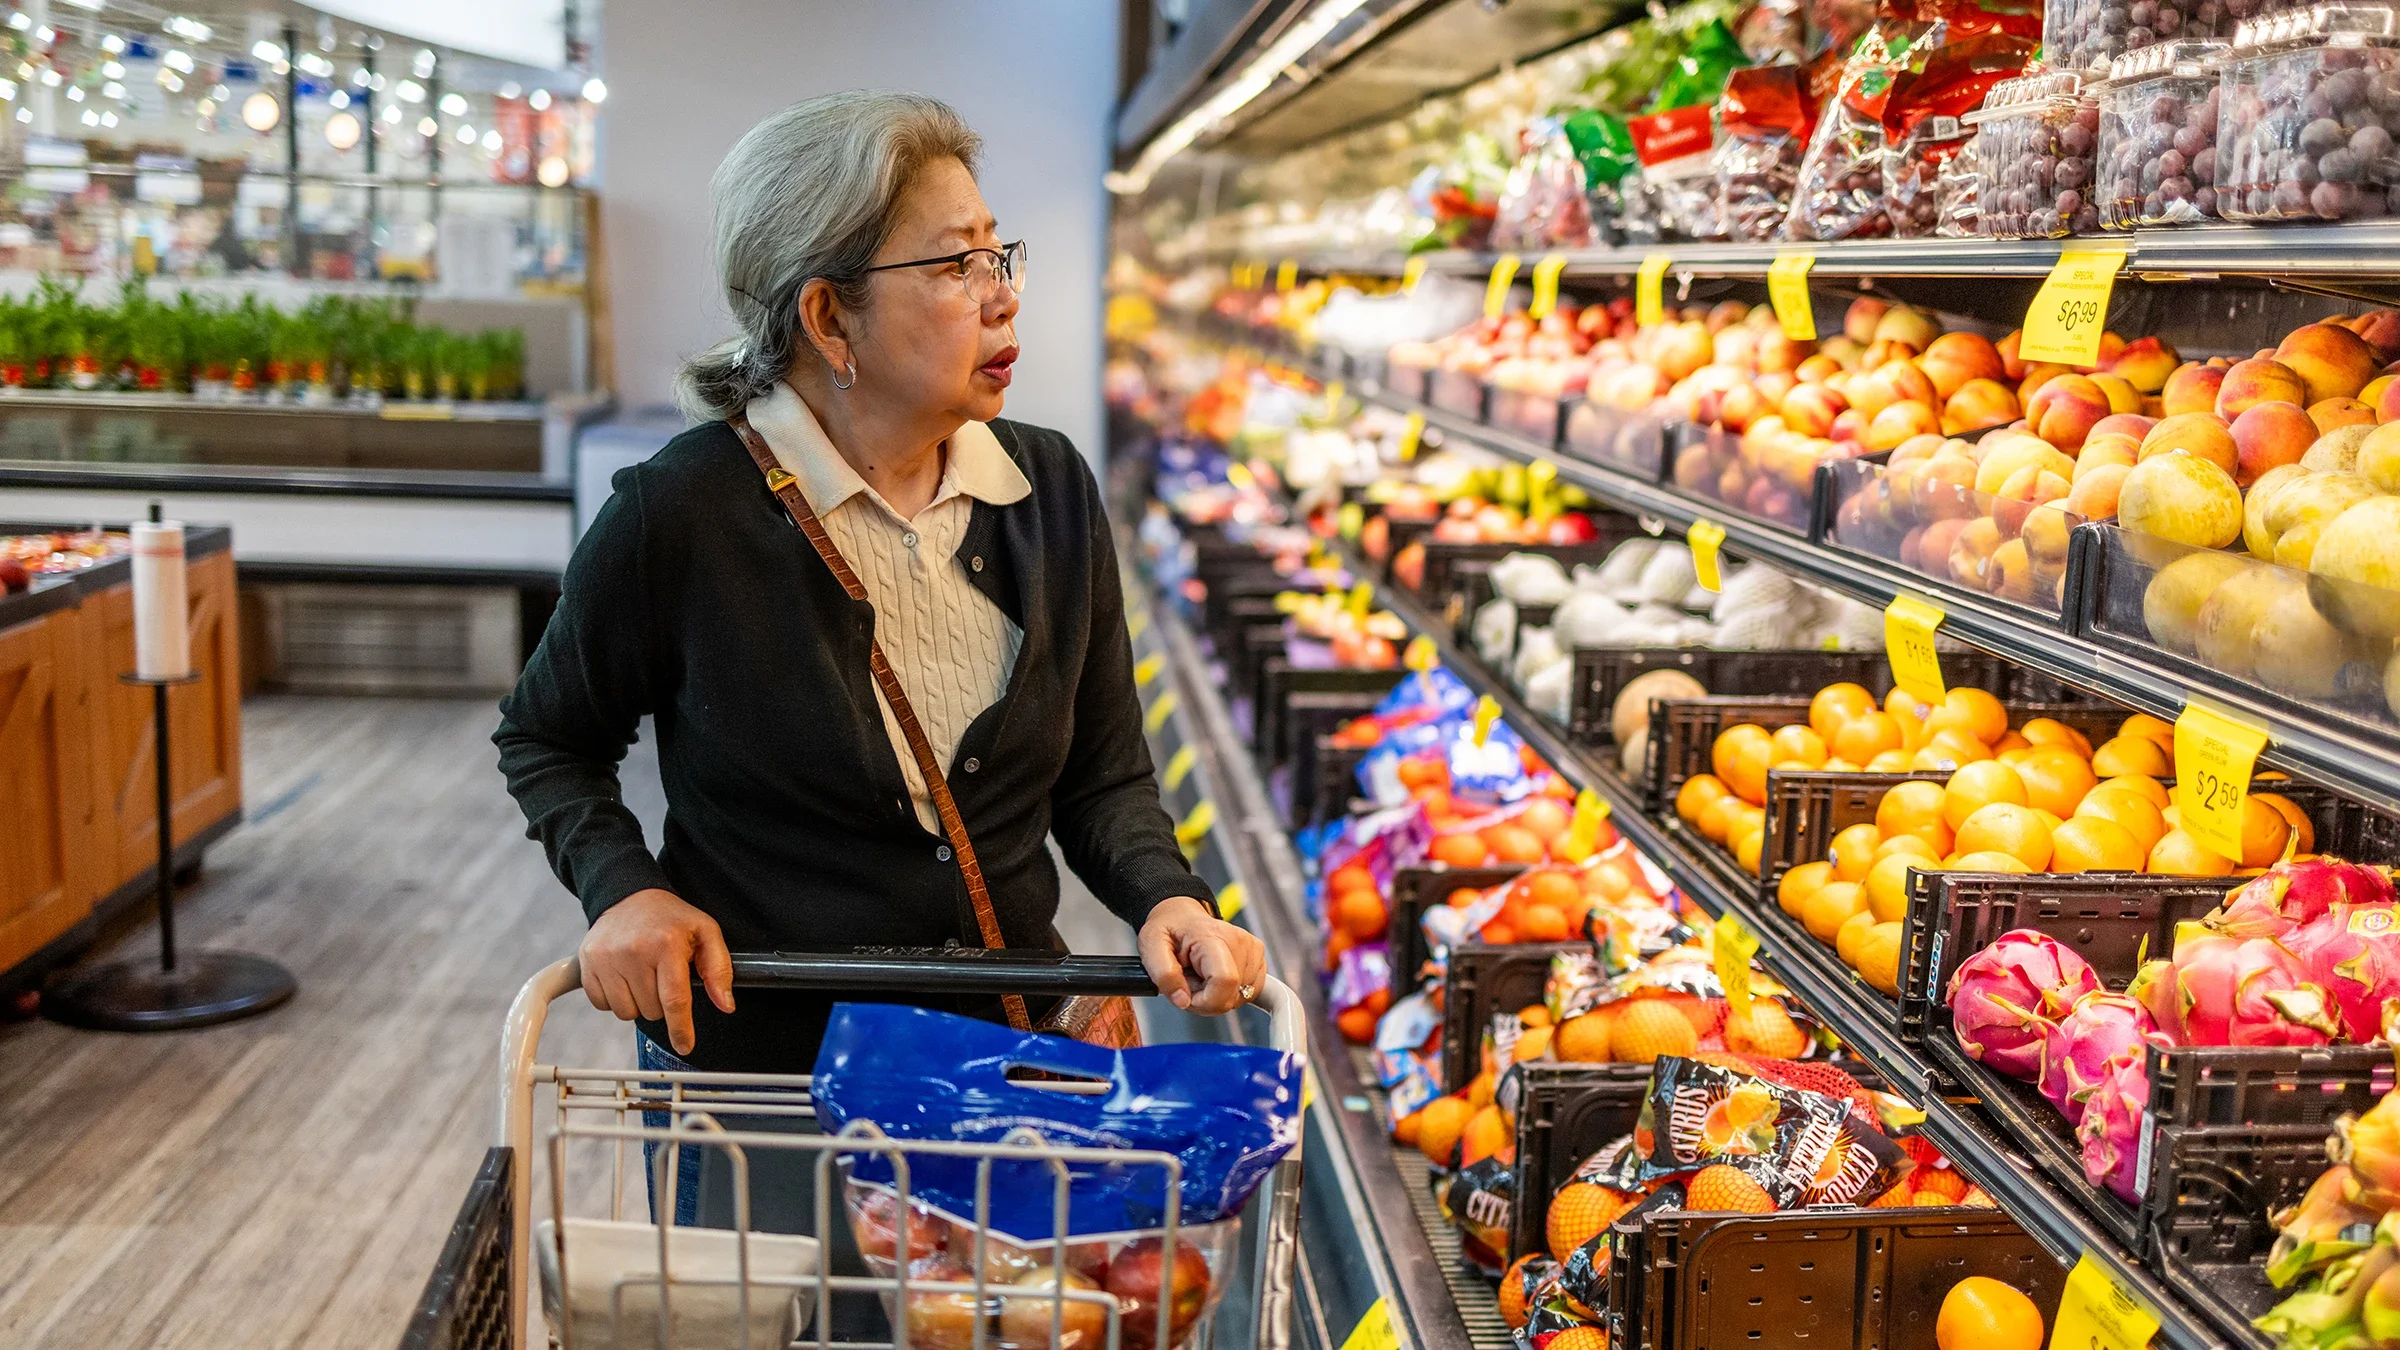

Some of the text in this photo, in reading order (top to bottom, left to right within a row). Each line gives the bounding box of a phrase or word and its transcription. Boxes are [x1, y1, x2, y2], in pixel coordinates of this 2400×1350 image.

[2203, 736, 2229, 756] SPECIAL
[852, 945, 990, 958] THANK YOU
[1669, 1084, 1709, 1164] CITRUS
